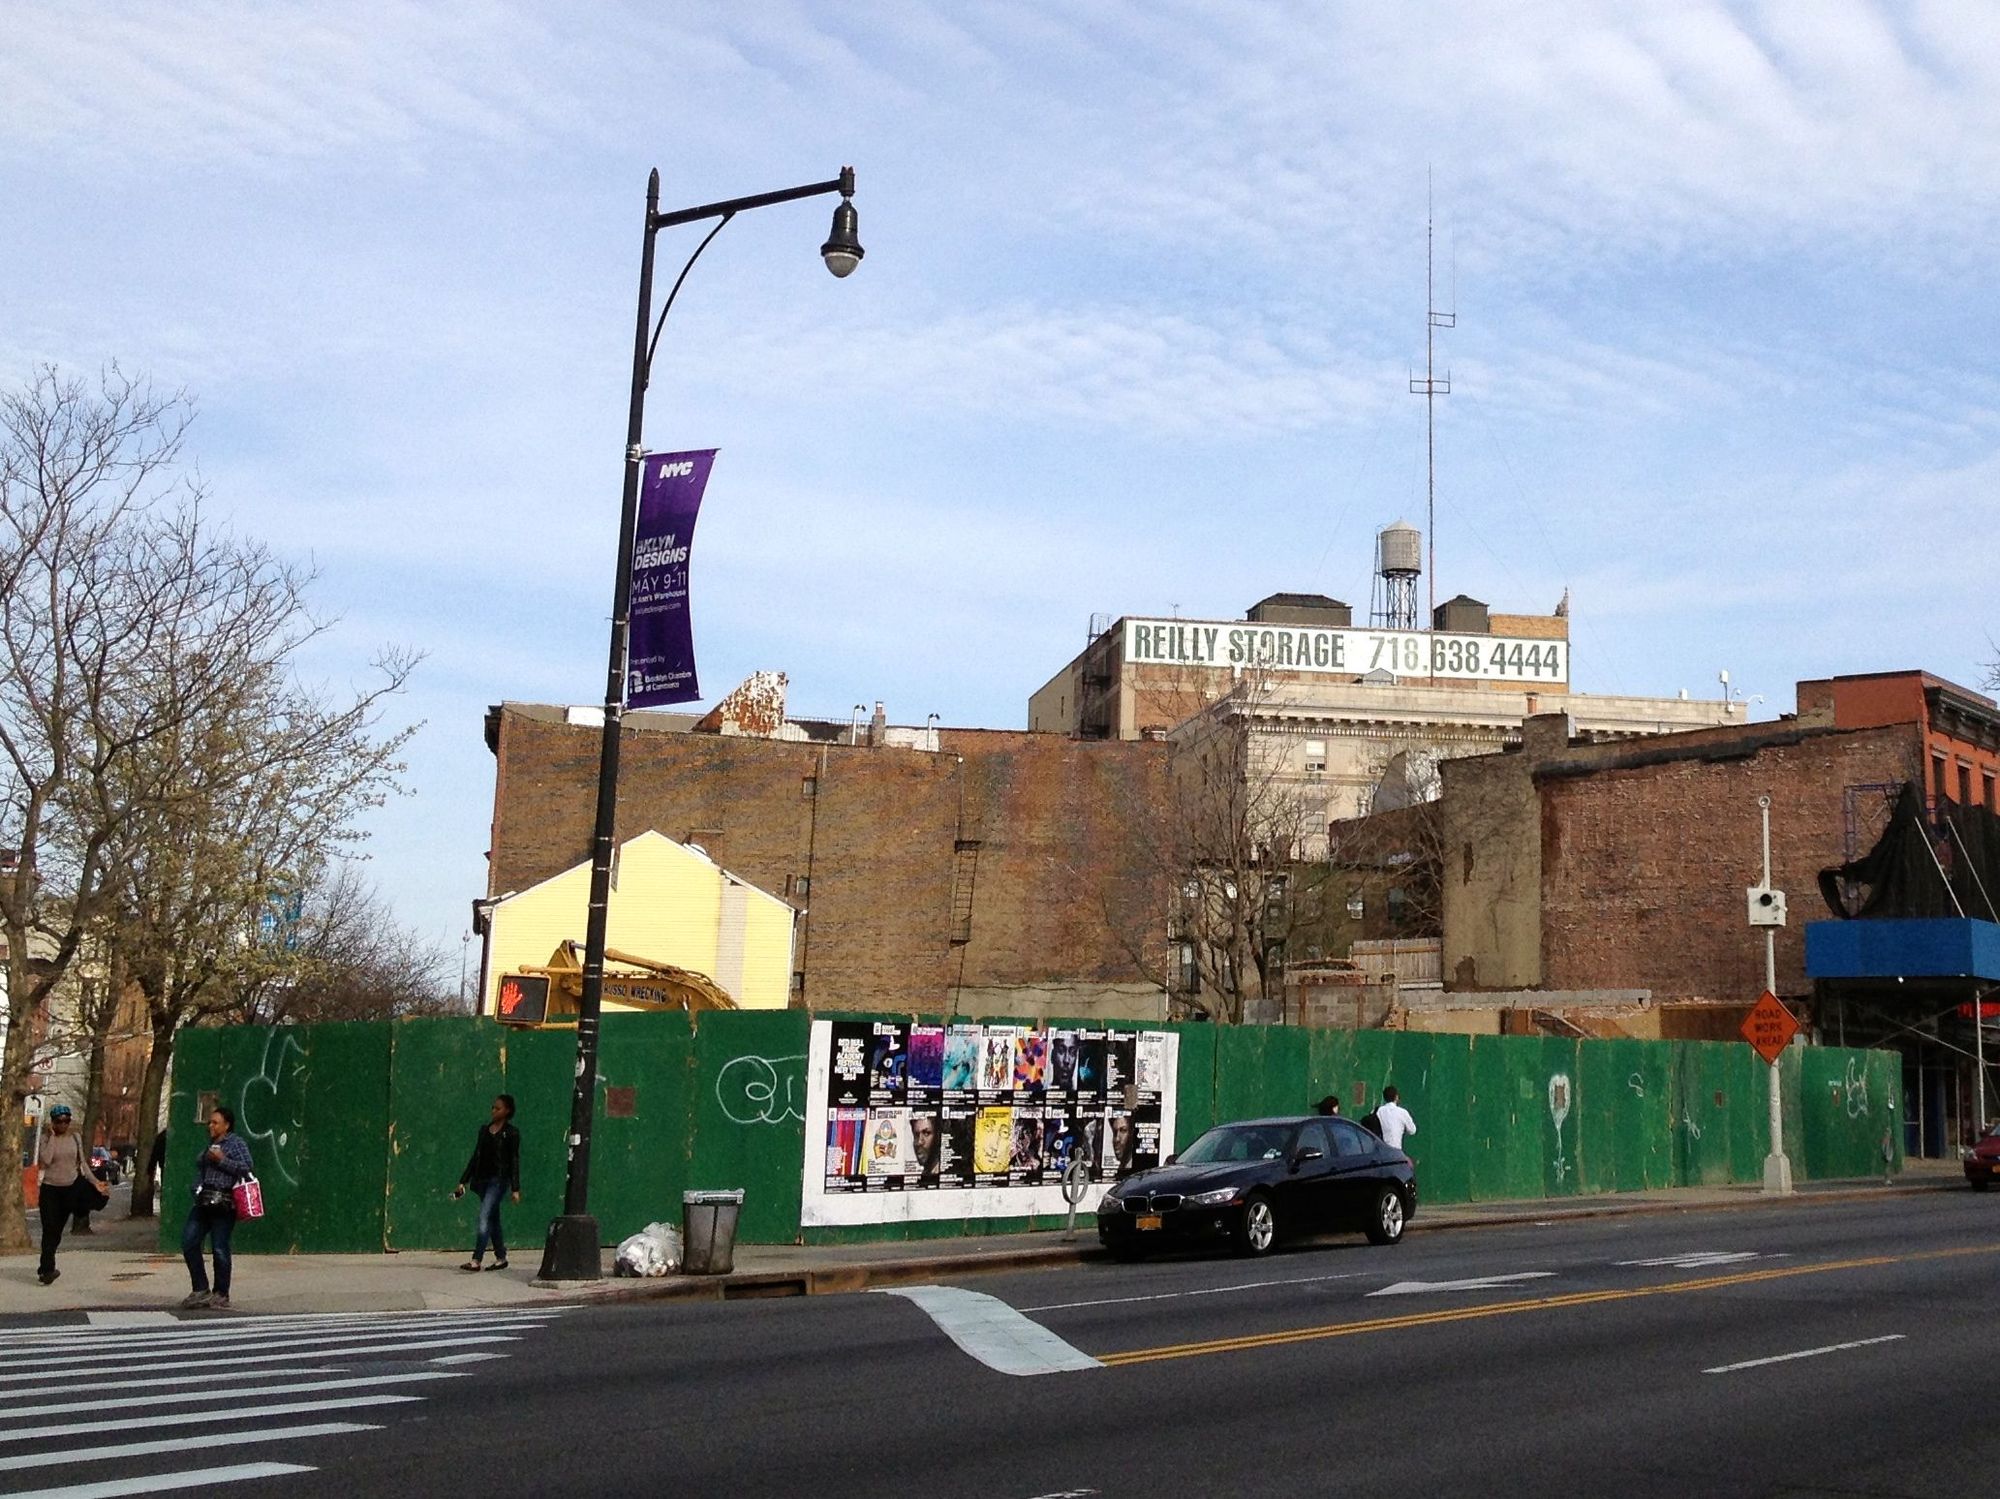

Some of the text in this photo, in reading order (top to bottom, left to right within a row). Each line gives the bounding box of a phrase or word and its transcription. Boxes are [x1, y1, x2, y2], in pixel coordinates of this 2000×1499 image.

[659, 461, 694, 479] NYC
[635, 534, 675, 554] BKLYN
[634, 546, 688, 571] DESIGNS
[632, 571, 687, 595] MAY 9-11
[1134, 624, 1560, 677] REILLY STORAGE 718.638.4444
[1755, 1009, 1782, 1020] ROAD
[1755, 1022, 1783, 1033] WORK
[1756, 1035, 1783, 1047] AHEAD
